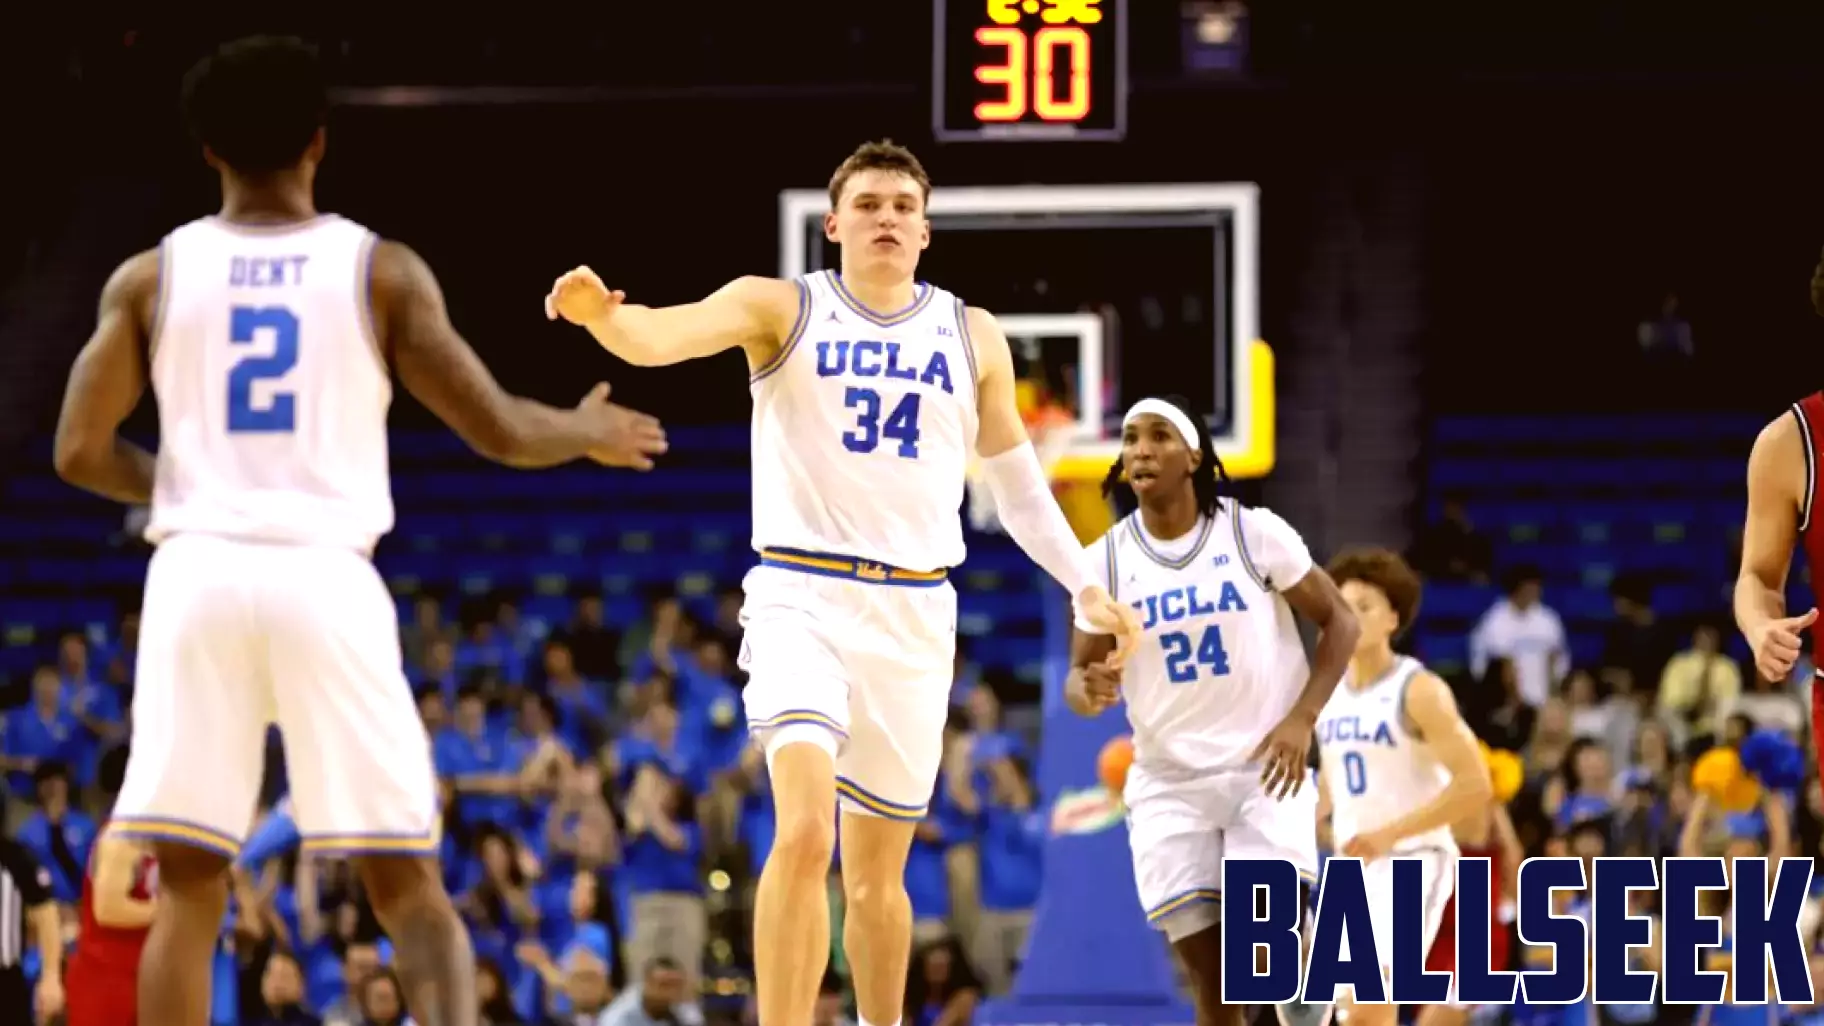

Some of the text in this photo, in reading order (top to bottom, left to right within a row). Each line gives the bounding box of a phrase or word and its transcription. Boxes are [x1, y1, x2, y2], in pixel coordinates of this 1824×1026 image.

[974, 27, 1090, 120] 30
[229, 255, 309, 287] DENT
[226, 304, 300, 433] 2
[816, 340, 954, 395] UCLA
[842, 386, 921, 459] 34
[1159, 631, 1230, 683] 24
[1343, 751, 1367, 796] 0
